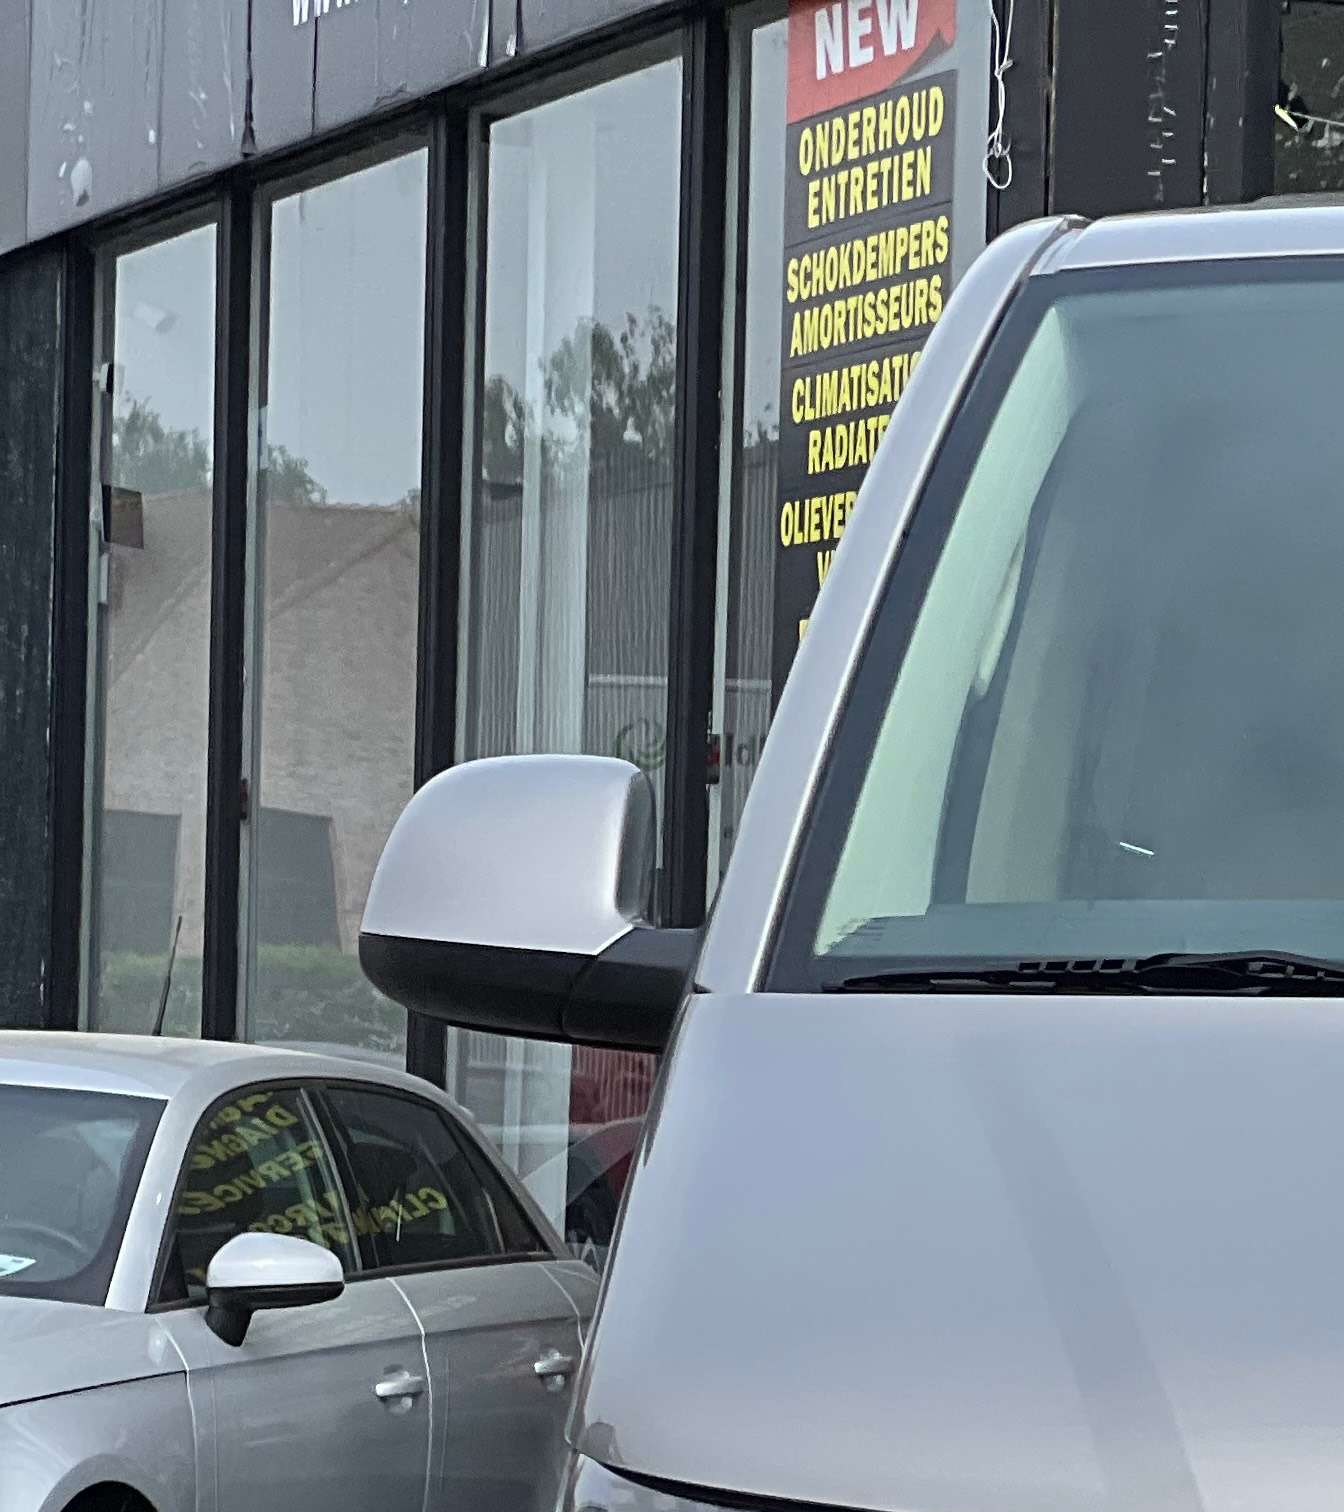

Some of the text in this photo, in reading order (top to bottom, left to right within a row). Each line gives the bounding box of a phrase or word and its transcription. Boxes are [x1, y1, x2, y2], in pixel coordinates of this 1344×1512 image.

[815, 0, 919, 81] NEW
[798, 86, 944, 176] ONDERHOUD
[807, 146, 932, 229] ENTRETIEN
[786, 216, 949, 303] SCHOKDEMPERS
[789, 274, 942, 358] AMORTISSEURS
